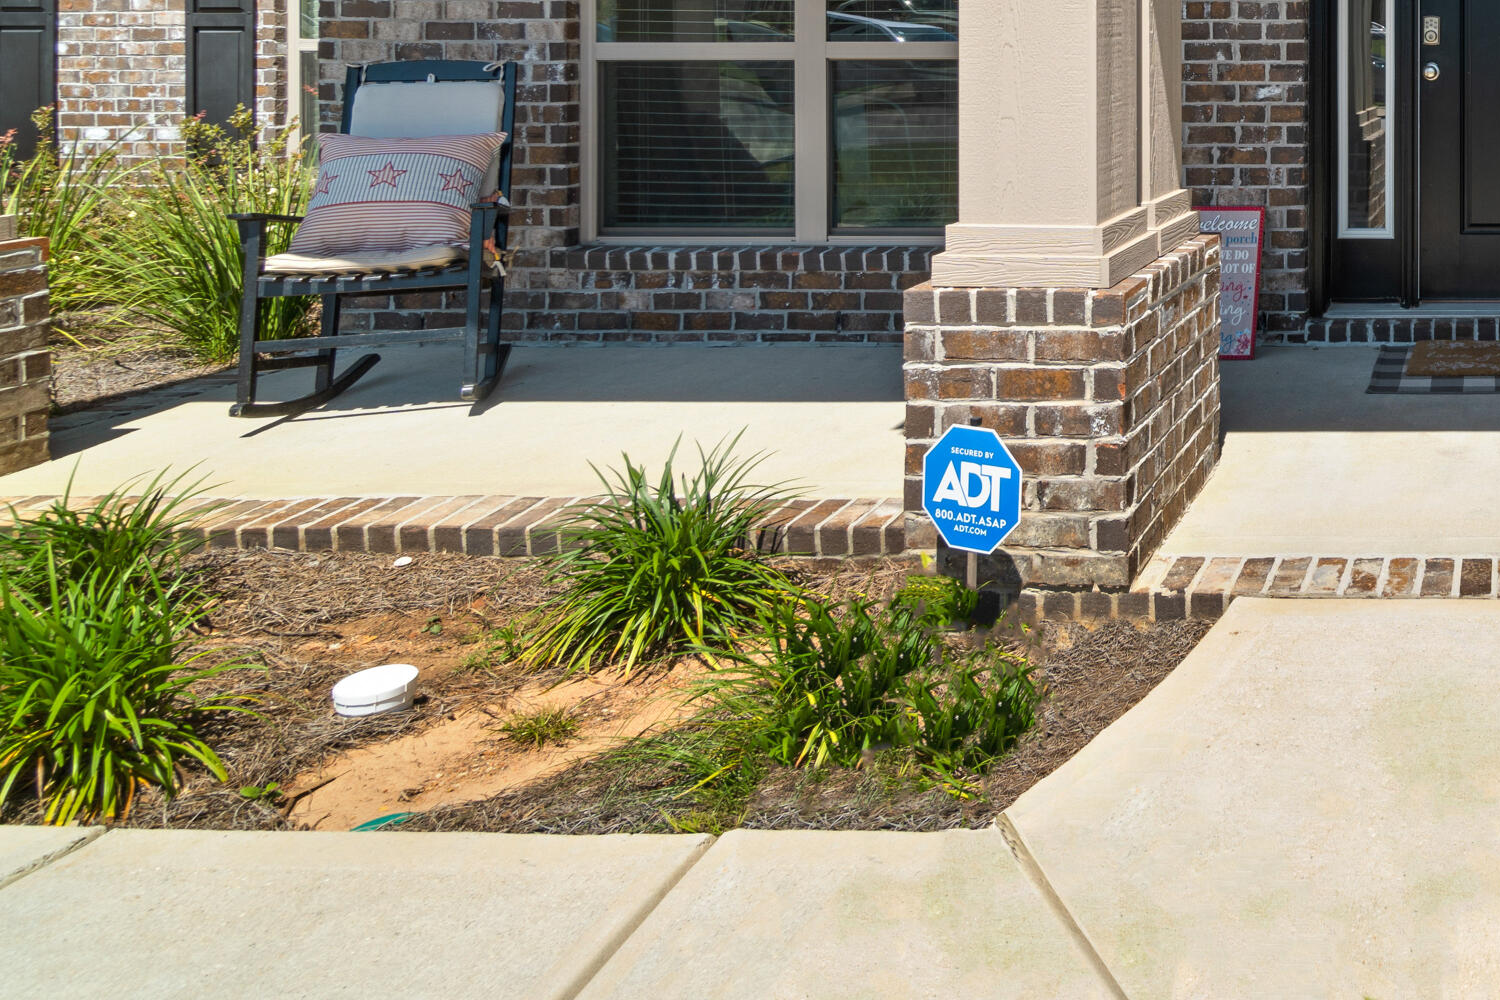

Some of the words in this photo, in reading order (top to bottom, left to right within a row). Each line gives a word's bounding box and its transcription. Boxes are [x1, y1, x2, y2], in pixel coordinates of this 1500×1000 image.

[1225, 232, 1257, 247] porch
[1235, 250, 1249, 260] DO
[1241, 263, 1256, 274] OF
[951, 446, 984, 458] SECURED
[984, 451, 994, 459] BY
[932, 460, 1011, 512] ADT
[935, 508, 1007, 529] 800.ADT.ASAP
[954, 524, 987, 536] ADT.COM
